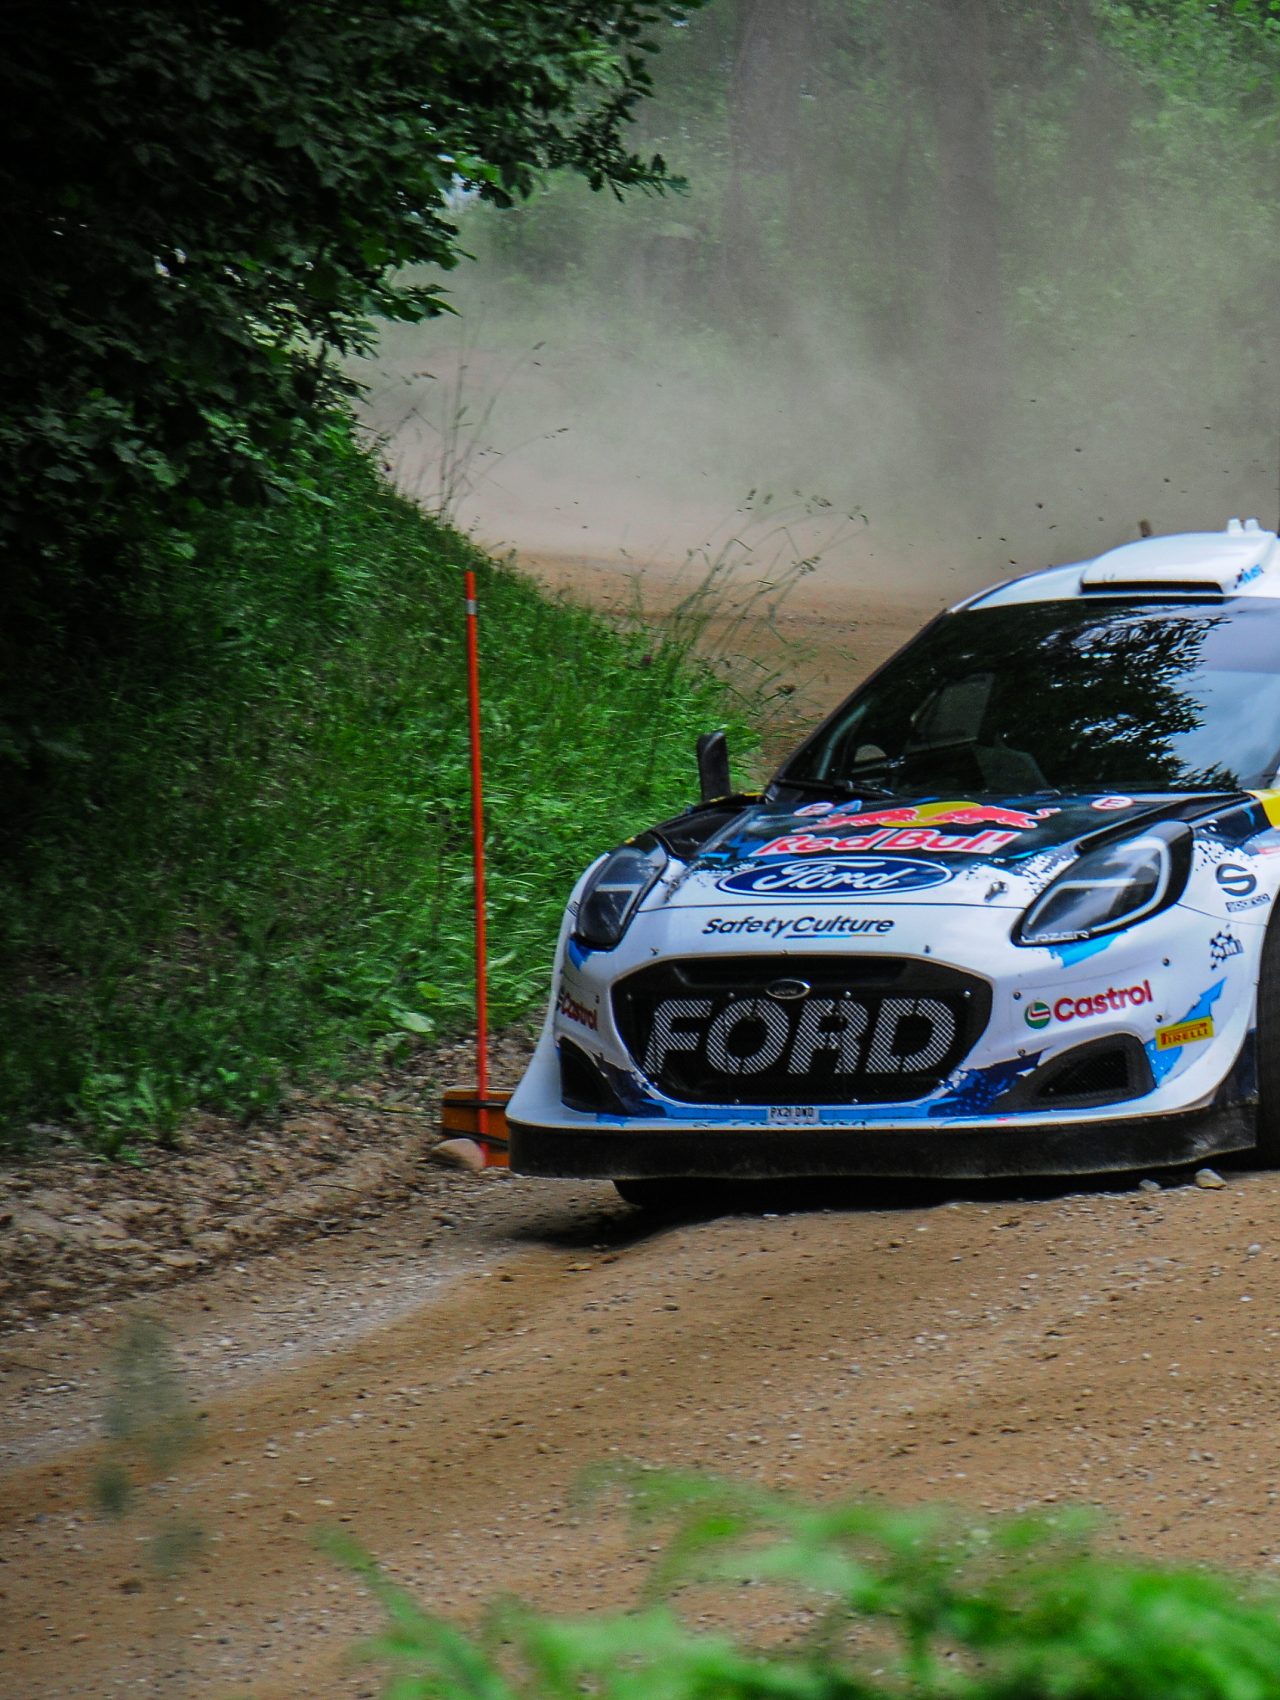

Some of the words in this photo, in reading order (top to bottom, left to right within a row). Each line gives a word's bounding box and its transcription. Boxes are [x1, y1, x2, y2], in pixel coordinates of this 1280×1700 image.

[750, 829, 894, 856] Red
[873, 829, 1021, 854] Bull
[752, 860, 916, 891] Ford
[702, 915, 895, 938] SafetyCulture
[1053, 979, 1153, 1022] Castrol
[642, 999, 955, 1075] FORD
[1160, 1022, 1207, 1045] PIRELLI
